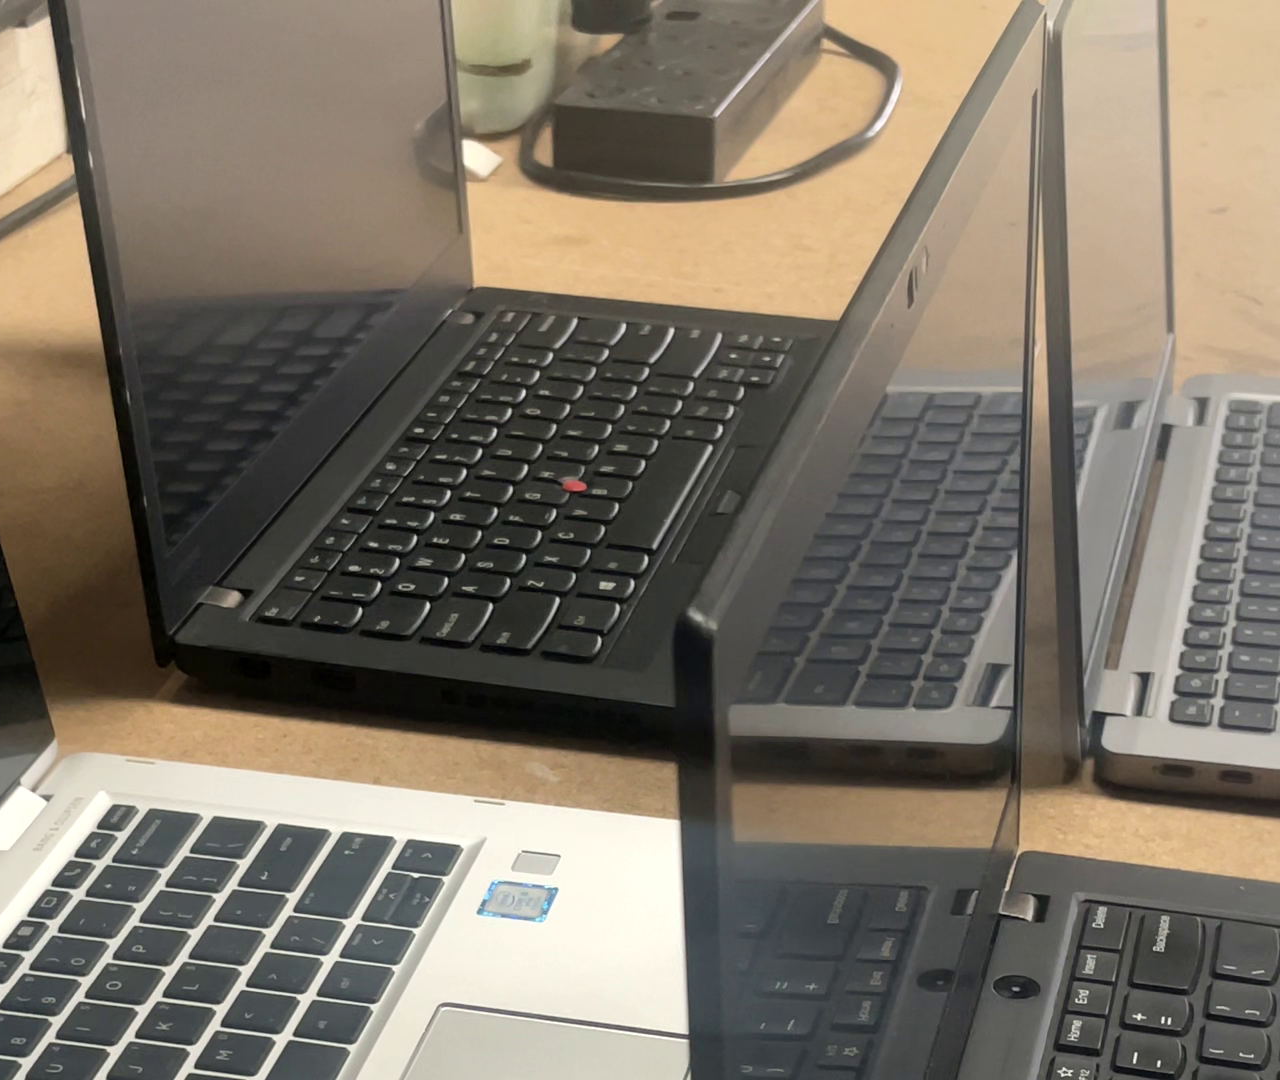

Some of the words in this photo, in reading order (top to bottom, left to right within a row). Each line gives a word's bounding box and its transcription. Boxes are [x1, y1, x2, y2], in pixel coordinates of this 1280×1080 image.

[1092, 906, 1108, 928] Delete
[1153, 915, 1170, 953] Backspace
[131, 945, 146, 953] P
[1082, 955, 1097, 974] Insert
[106, 981, 122, 990] O
[41, 996, 56, 1004] 9
[1075, 990, 1089, 1005] End
[155, 1021, 173, 1031] K
[1067, 1020, 1082, 1042] Home
[11, 1037, 26, 1045] 8
[215, 1050, 233, 1060] M
[45, 1064, 63, 1073] U
[129, 1065, 143, 1073] J
[1079, 1069, 1090, 1080] F12
